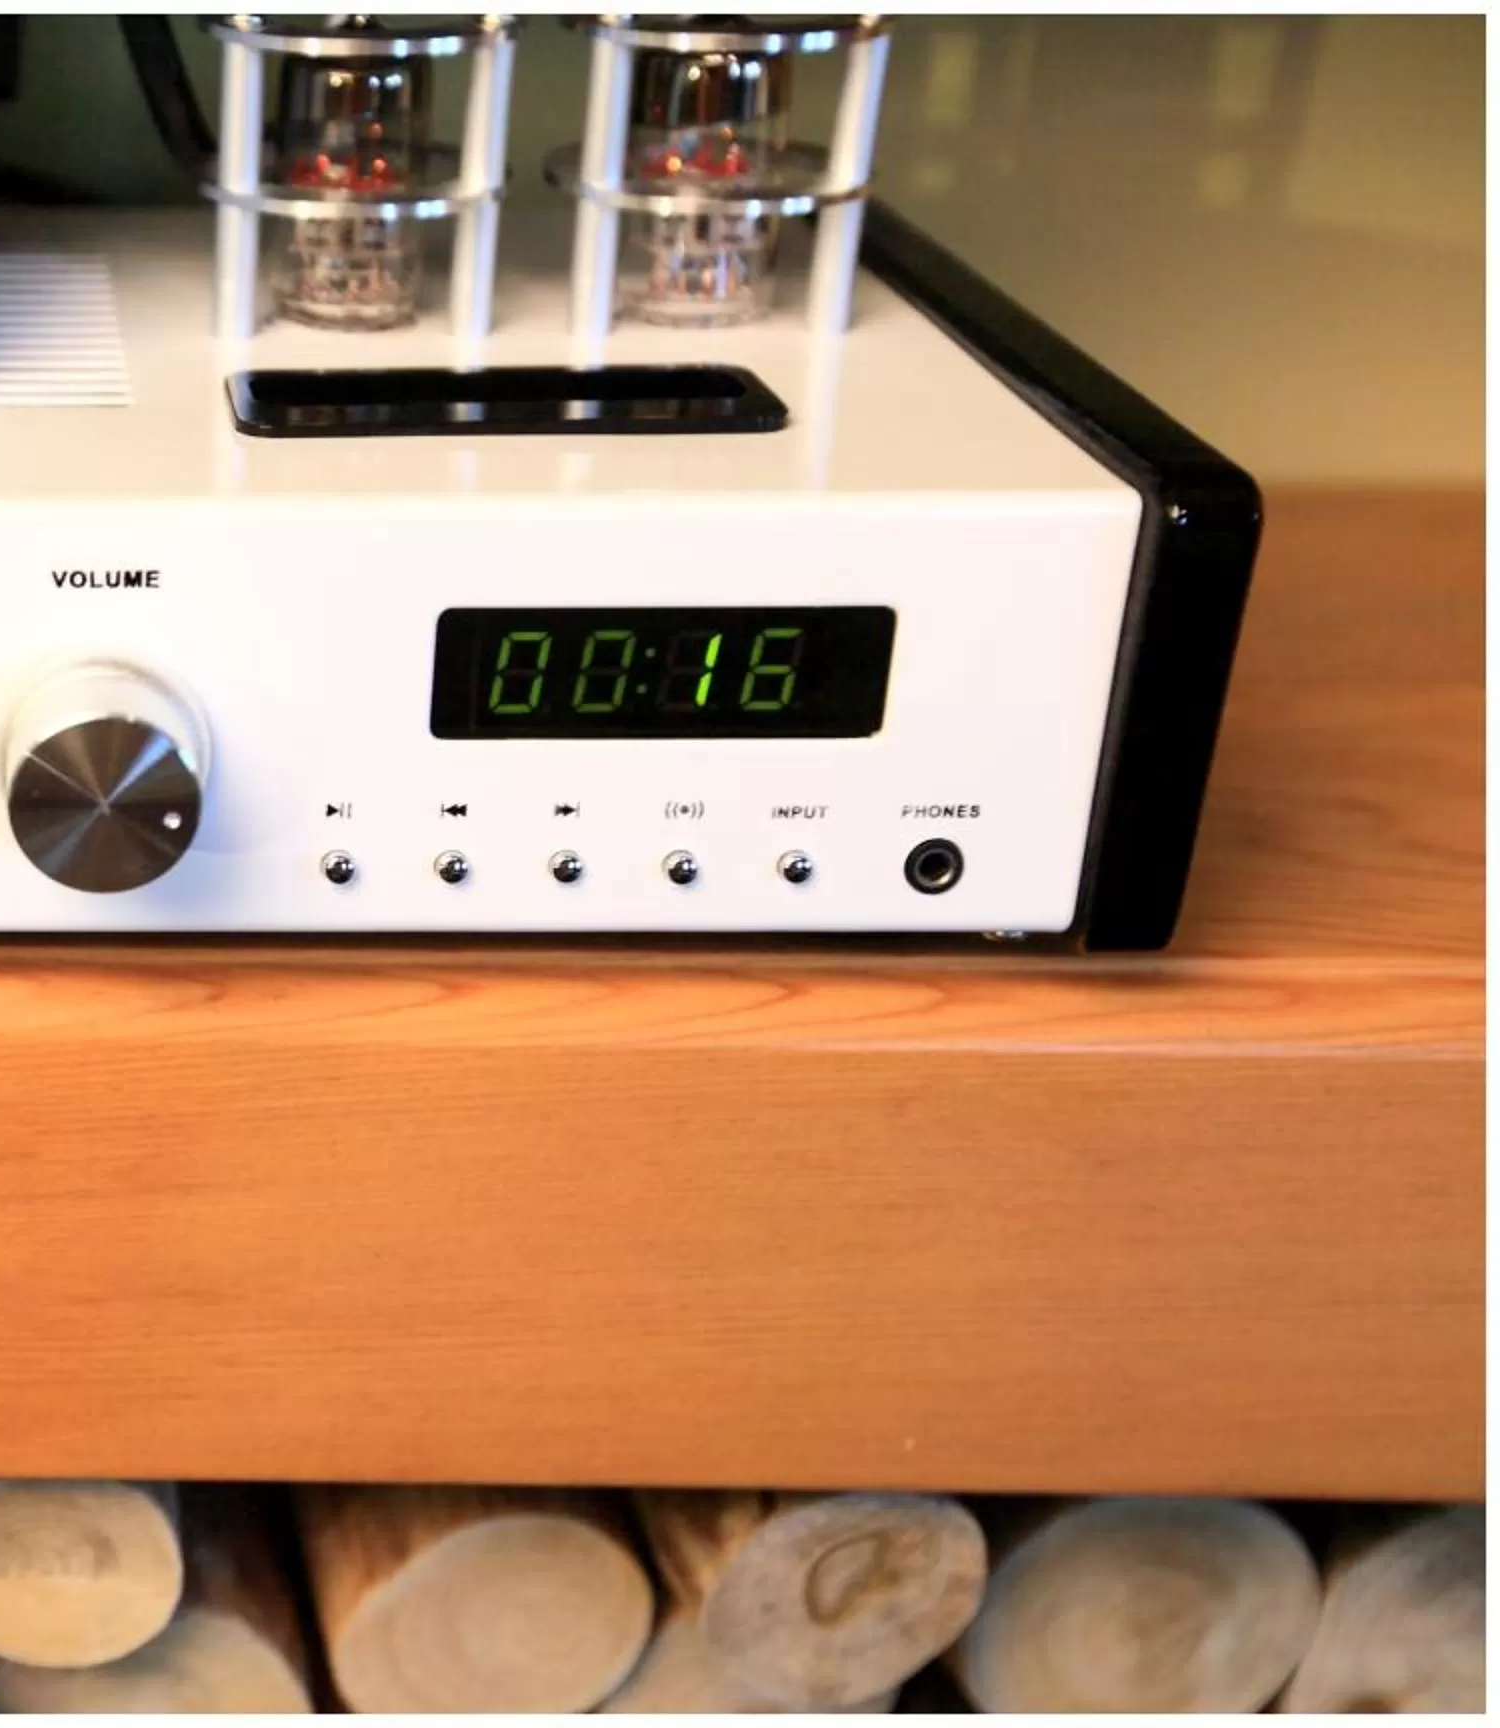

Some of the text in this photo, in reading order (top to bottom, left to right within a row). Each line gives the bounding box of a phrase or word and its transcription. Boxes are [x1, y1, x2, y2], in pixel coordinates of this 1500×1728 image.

[51, 570, 161, 589] VOLUME
[488, 627, 804, 714] 00:16
[771, 804, 829, 820] INPUT
[901, 803, 981, 819] PHONES
